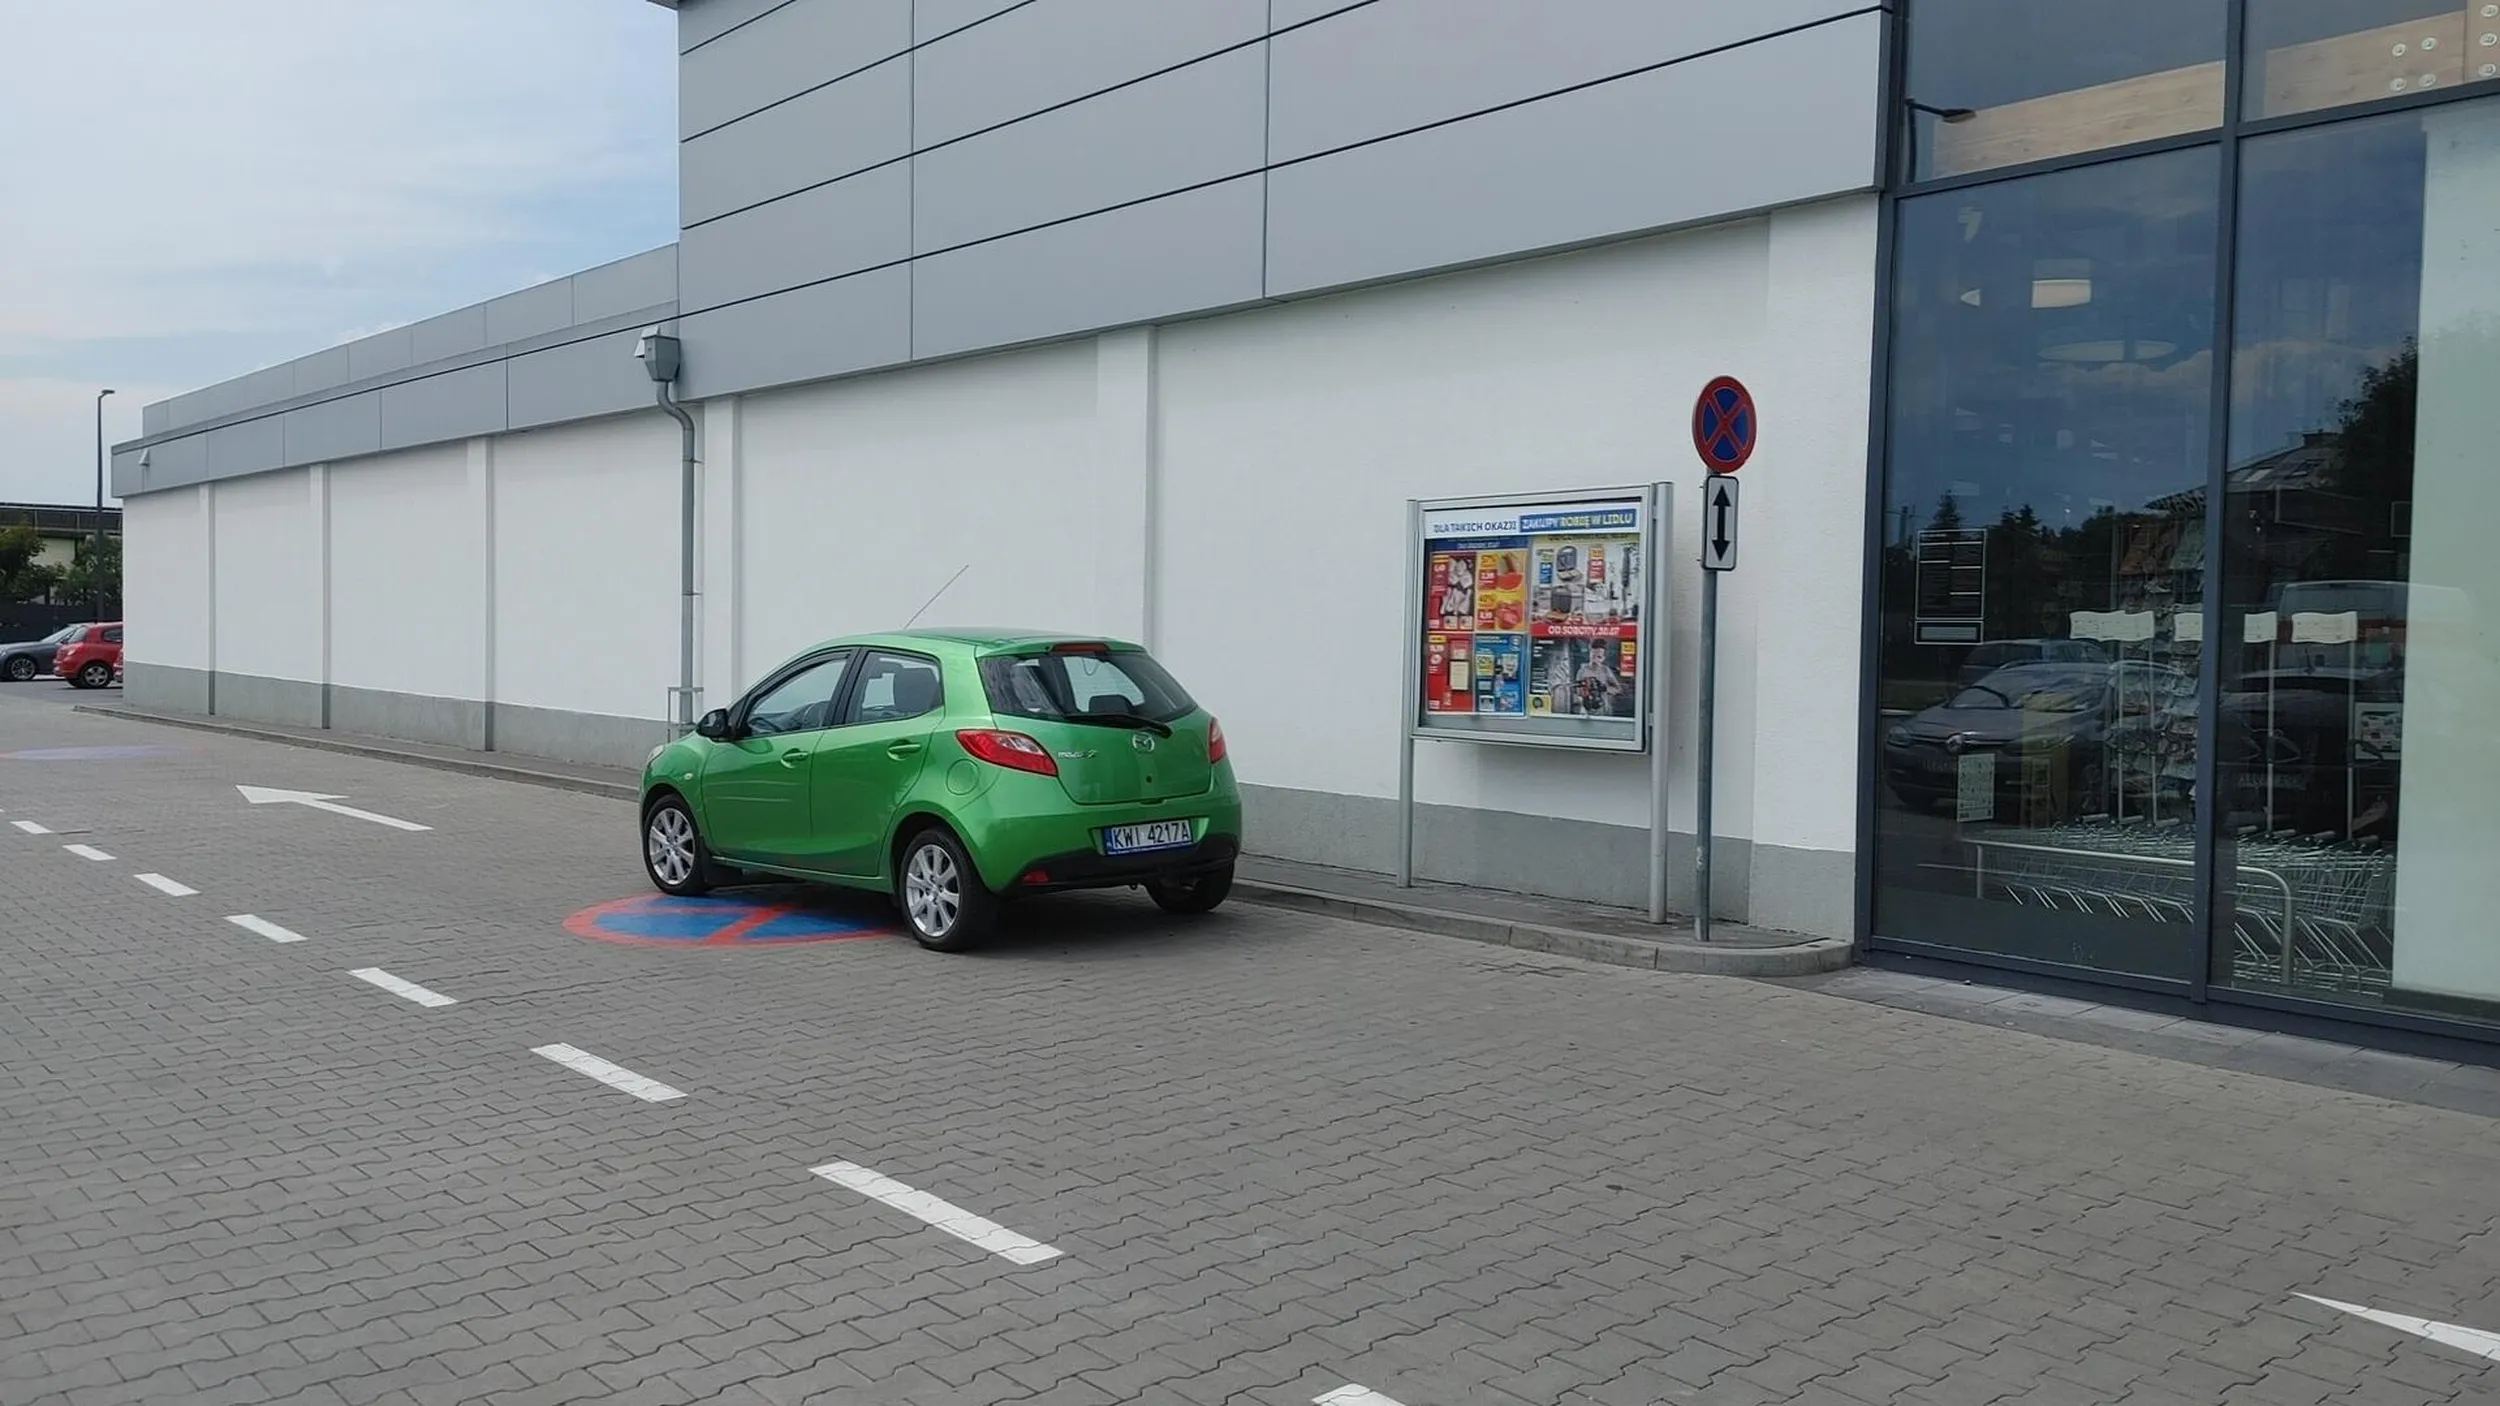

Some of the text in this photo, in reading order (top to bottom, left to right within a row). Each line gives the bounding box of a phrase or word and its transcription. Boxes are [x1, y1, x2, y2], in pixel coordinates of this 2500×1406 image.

[1433, 523, 1449, 533] DLA
[1450, 522, 1483, 532] TAKICH
[1484, 520, 1517, 531] OKAZJI
[1521, 516, 1559, 529] ZAKUPY
[1591, 515, 1601, 525] W
[1602, 512, 1633, 525] LIDLU
[1547, 625, 1561, 635] OD
[1113, 821, 1190, 848] KWI 4217A
